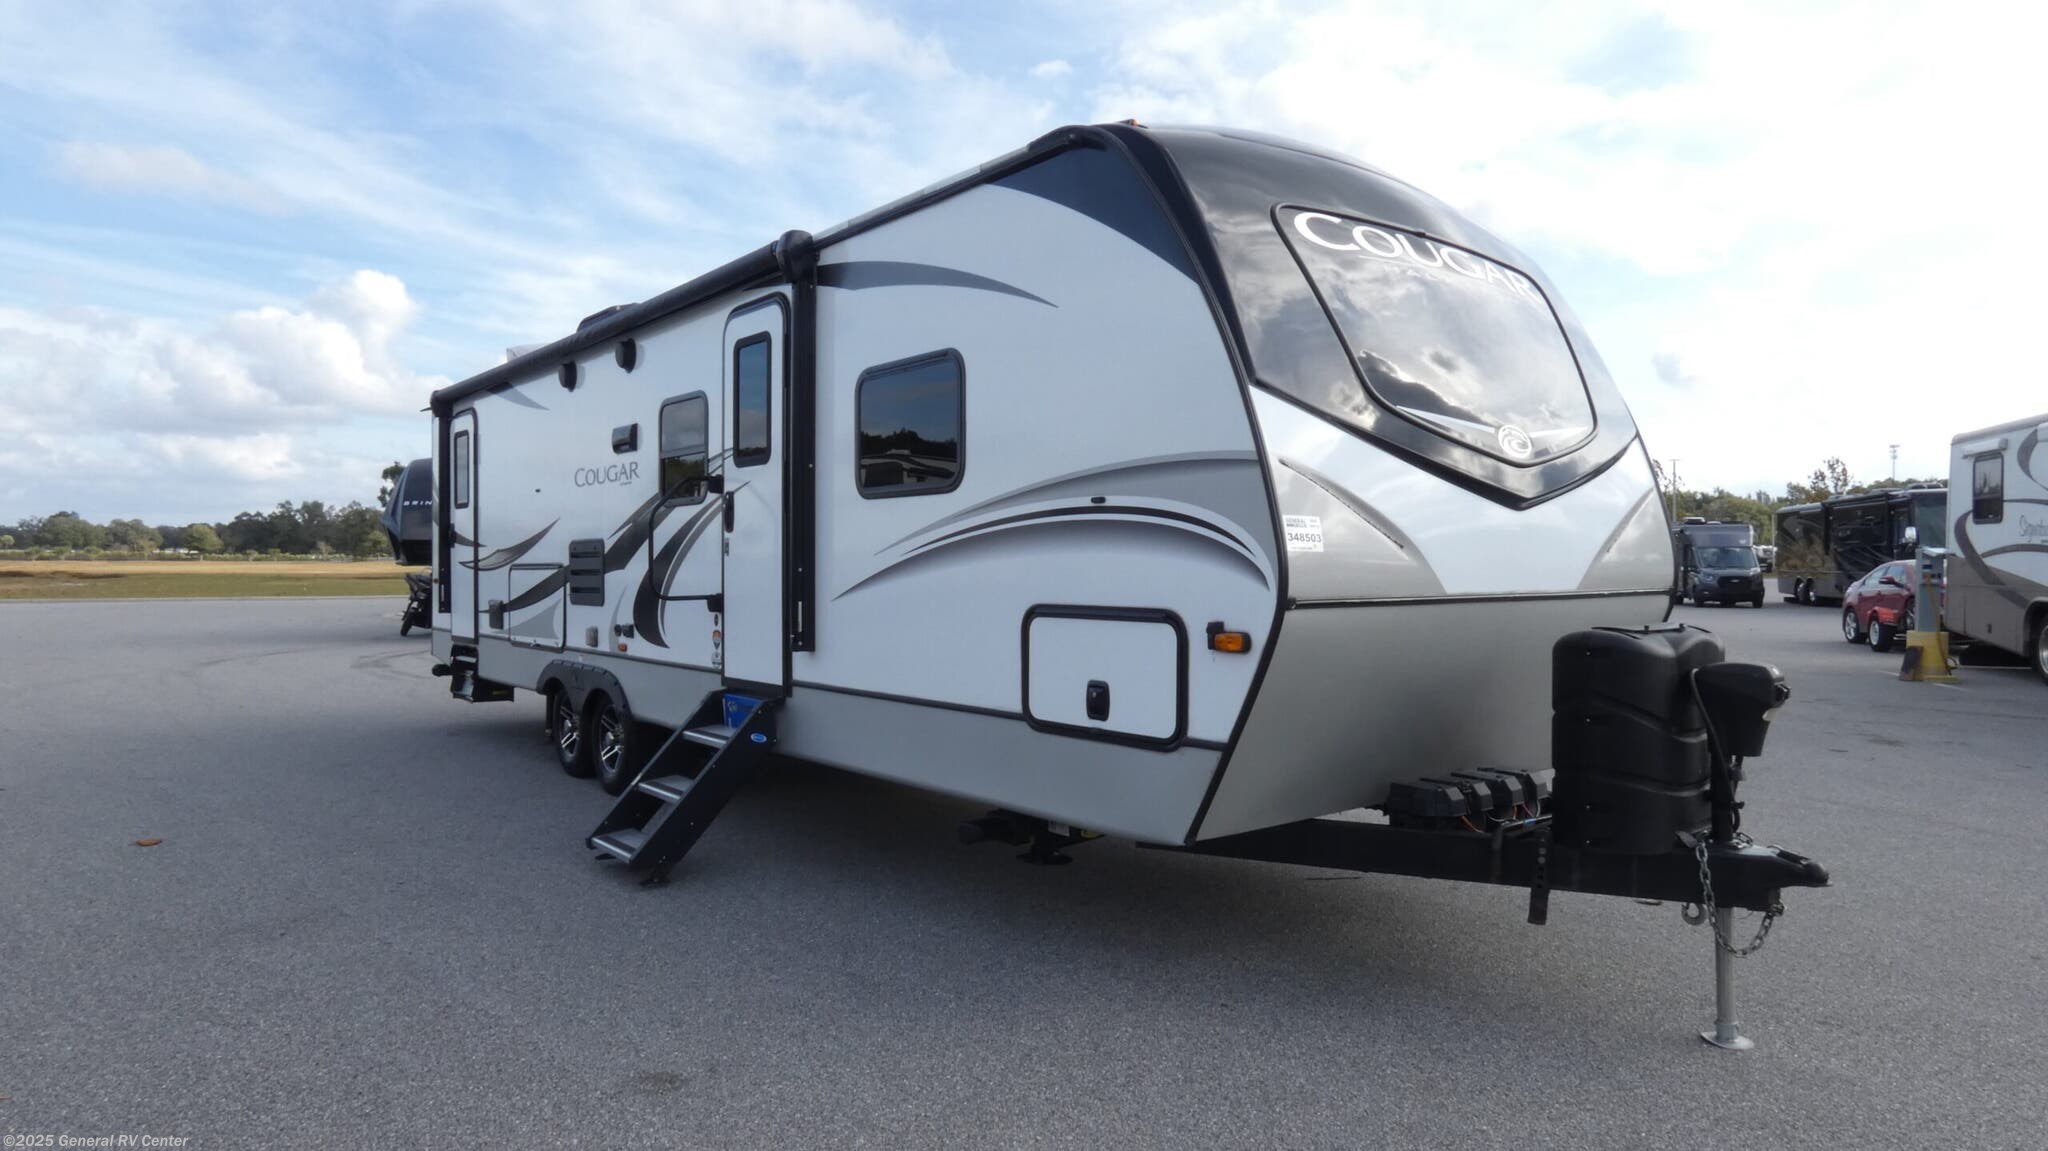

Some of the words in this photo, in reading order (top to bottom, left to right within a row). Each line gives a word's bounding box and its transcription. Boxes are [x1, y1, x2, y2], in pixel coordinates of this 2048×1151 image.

[1294, 211, 1542, 305] COUGAR
[574, 461, 640, 488] COUGAR
[1287, 532, 1322, 543] 348503
